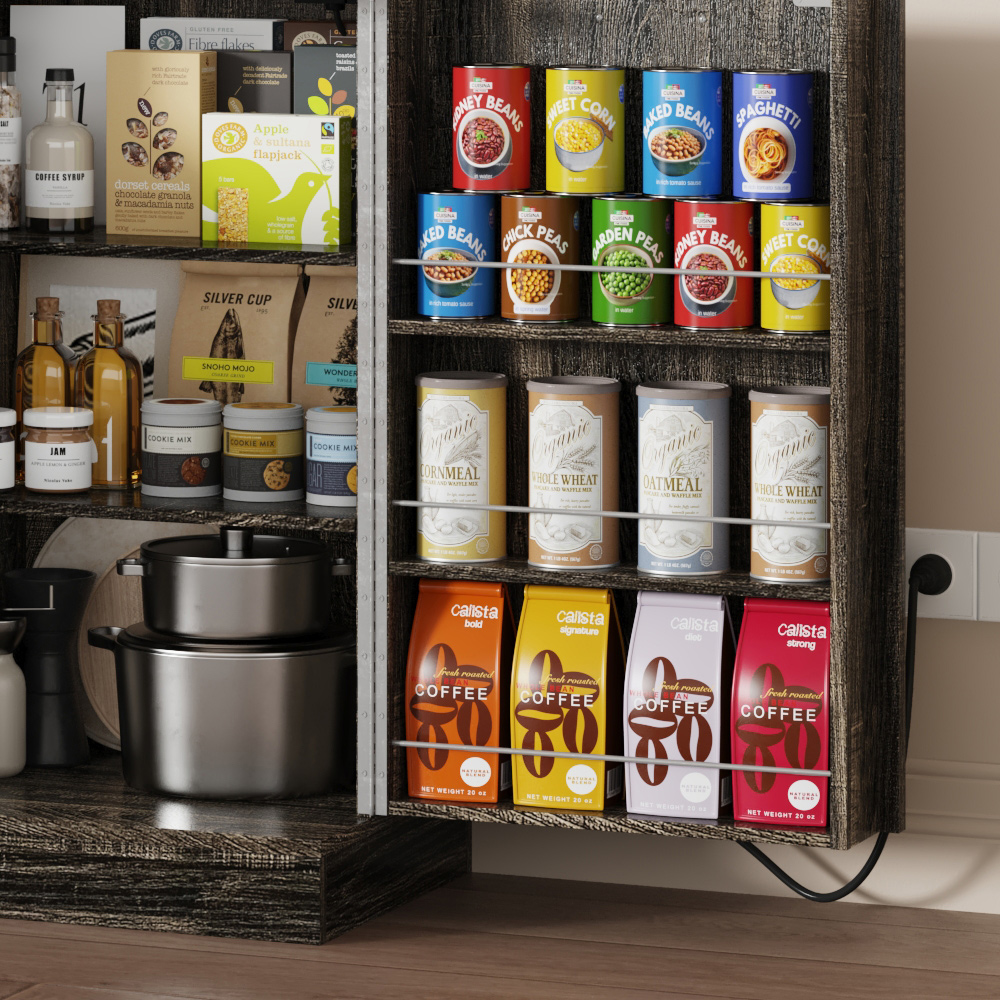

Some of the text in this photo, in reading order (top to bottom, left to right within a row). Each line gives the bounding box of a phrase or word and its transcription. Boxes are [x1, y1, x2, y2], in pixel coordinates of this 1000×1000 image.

[188, 37, 255, 51] Fibre flakes
[138, 100, 151, 116] new
[486, 95, 523, 133] BEANS
[547, 97, 616, 131] SWEET CORN
[675, 103, 715, 140] BEANS
[736, 101, 802, 130] SPAGHETTI
[253, 123, 289, 136] Apple
[217, 138, 246, 153] ORGANIC
[253, 136, 311, 147] & sultana
[253, 149, 302, 162] flapjack
[35, 172, 85, 182] COFFEE SYRUP
[114, 179, 191, 192] dorset cereals
[114, 189, 192, 201] chocolate granola
[114, 199, 195, 210] & macadamia nuts
[266, 222, 295, 230] wholegrain
[418, 225, 487, 261] AKED BEANS
[503, 224, 569, 254] CHICK PEAS
[593, 227, 664, 263] GARDEN PEAS
[675, 230, 748, 268] KIDNEY BEANS
[762, 233, 794, 266] SWEET
[203, 291, 273, 306] SILVER CUP
[327, 297, 358, 310] SILVE
[202, 362, 255, 373] SNOHO MOJO
[323, 367, 358, 377] WONDER
[148, 434, 193, 444] COOKIE MIX
[230, 438, 275, 448] COOKIE MIX
[531, 418, 592, 469] Organic
[50, 447, 66, 456] JAM
[313, 442, 358, 452] COOKIE MIX
[642, 424, 702, 472] Organic
[754, 429, 817, 478] Organic
[420, 463, 481, 480] CORNMEAL
[531, 471, 599, 486] WHOLE WHEAT
[643, 474, 703, 492] OATMEAL
[754, 482, 824, 497] WHOLE WHEAT
[450, 603, 499, 619] Calista
[464, 619, 483, 629] bold
[556, 610, 605, 626] Calista
[560, 625, 600, 636] signature
[670, 617, 719, 633] Calista
[777, 623, 827, 639] Calista
[684, 632, 703, 642] diet
[786, 639, 817, 651] strong
[433, 666, 495, 679] fresh roasted
[443, 678, 469, 686] BEAN
[539, 673, 601, 686] fresh roasted
[415, 684, 488, 700] COFFEE
[549, 684, 575, 693] BEAN
[652, 681, 715, 693] fresh roasted
[760, 687, 824, 700] fresh roasted
[520, 690, 594, 707] COFFEE
[663, 691, 689, 700] BEAN
[633, 697, 708, 714] COFFEE
[741, 704, 816, 722] COFFEE
[421, 785, 435, 793] NET
[436, 787, 465, 795] WEIGHT
[542, 795, 571, 803] WEIGHT
[640, 801, 654, 809] NET
[656, 803, 685, 812] WEIGHT
[763, 811, 793, 819] WEIGHT
